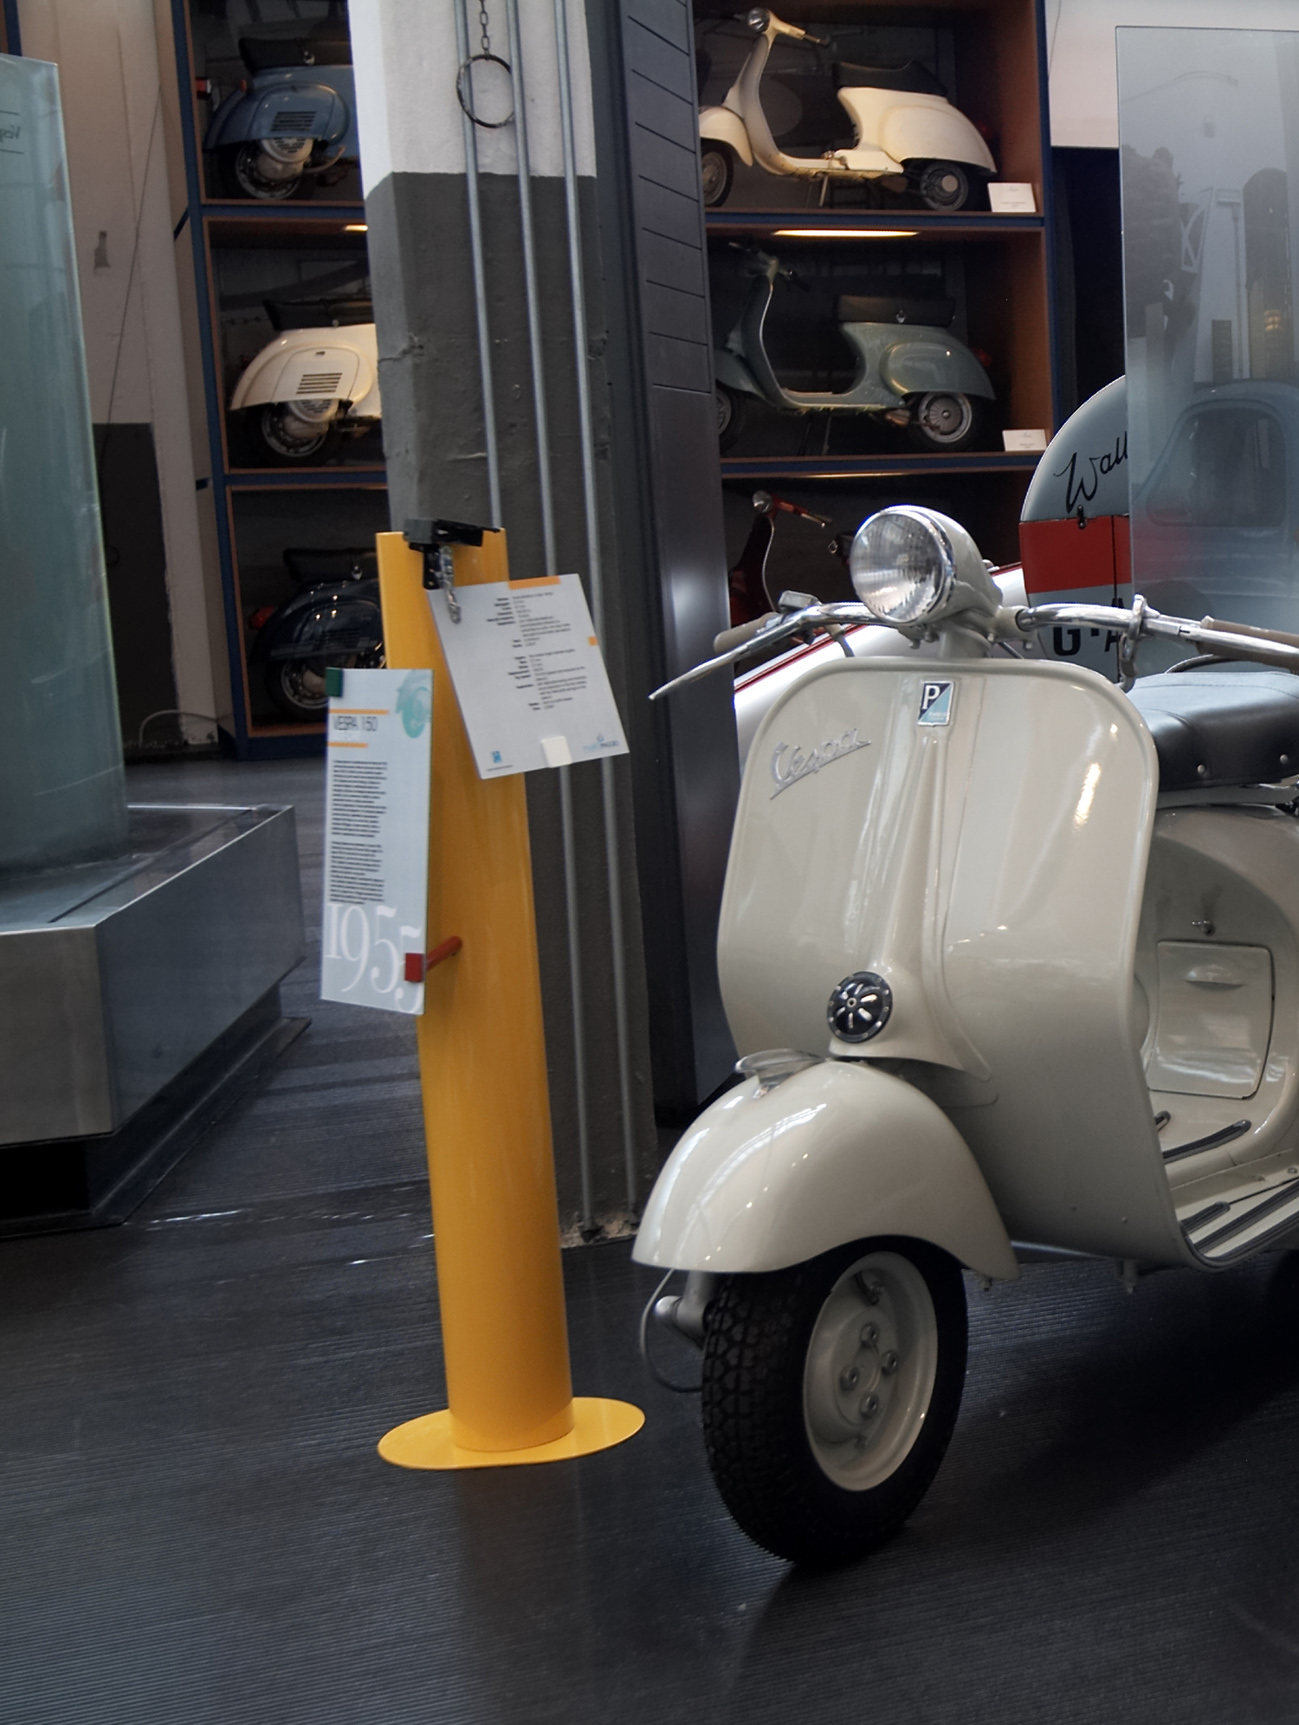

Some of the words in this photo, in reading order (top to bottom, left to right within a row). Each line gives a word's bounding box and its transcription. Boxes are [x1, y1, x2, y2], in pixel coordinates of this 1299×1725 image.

[921, 685, 941, 710] P
[332, 715, 360, 732] VESPA
[769, 728, 872, 800] Vespa
[325, 903, 424, 1014] 1955
